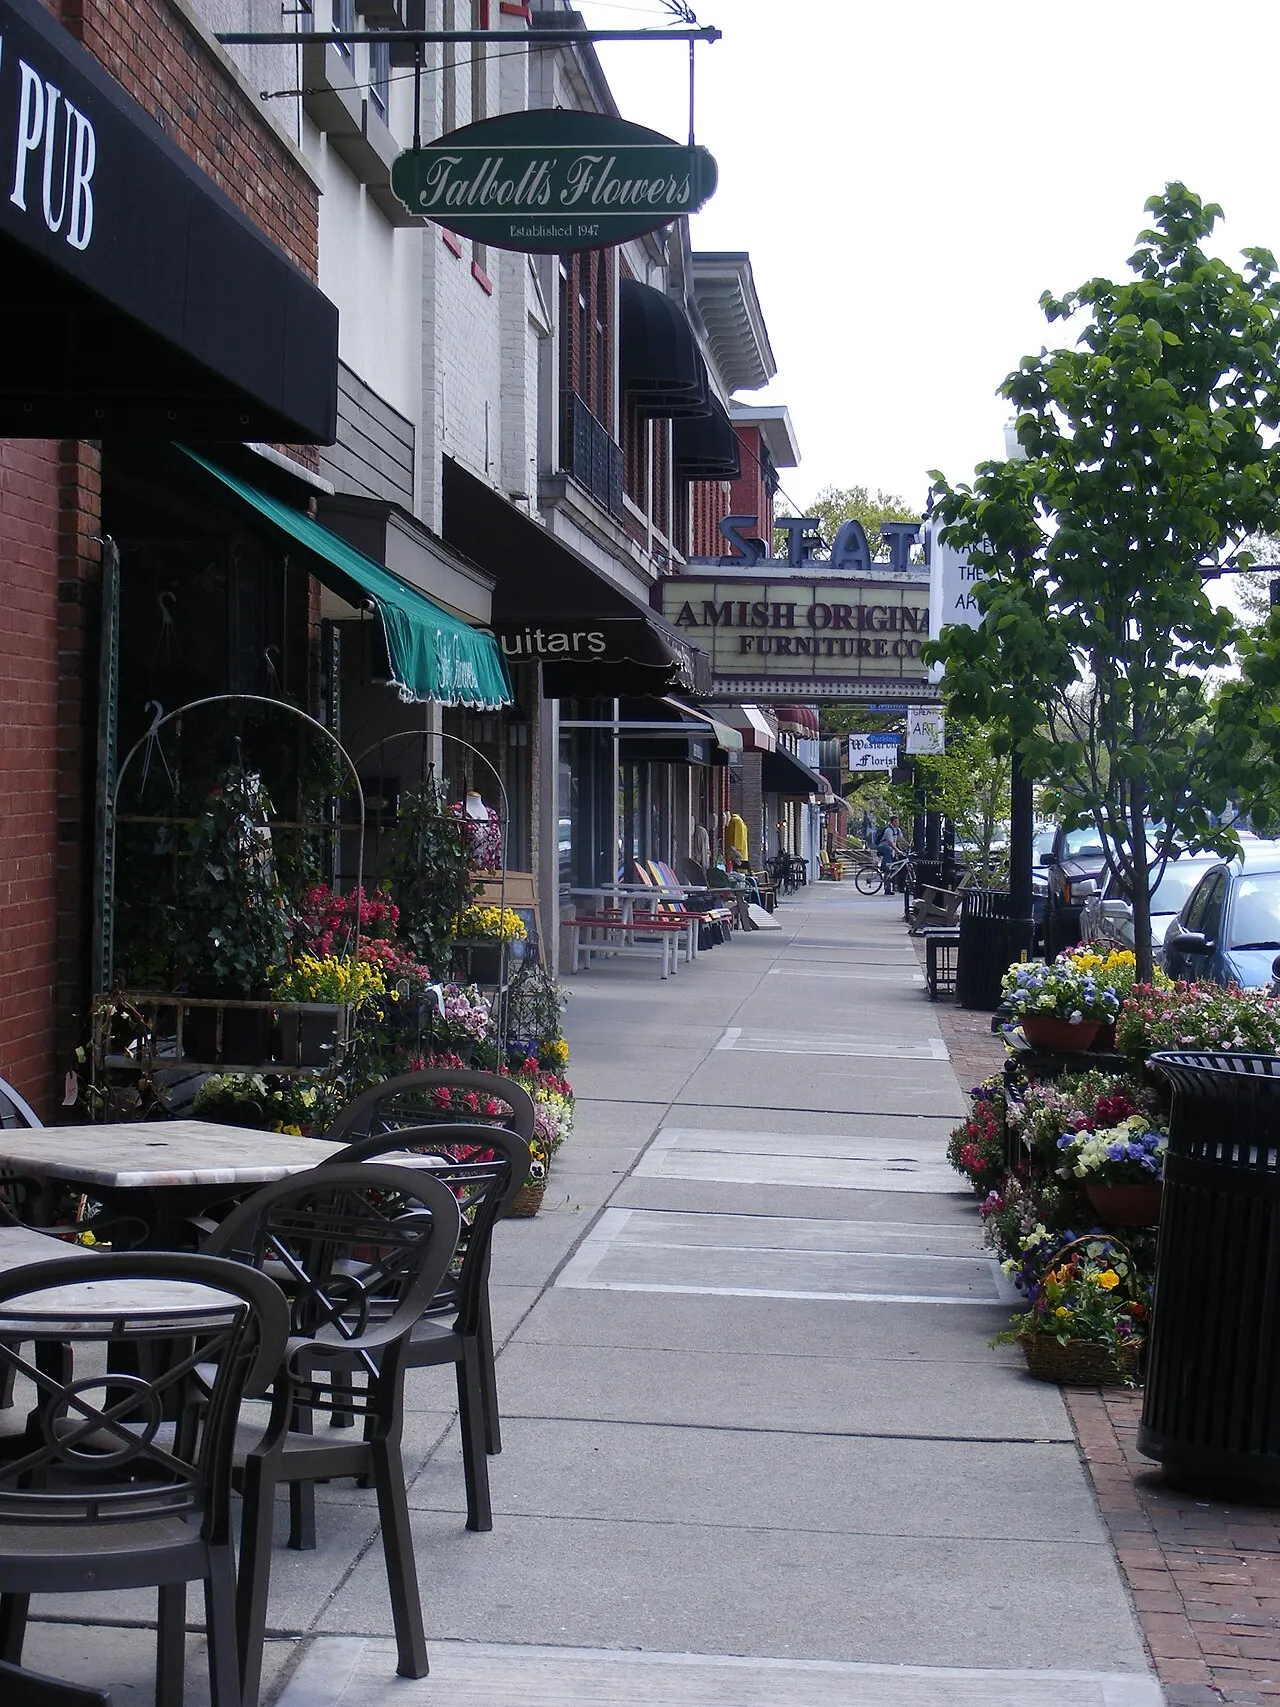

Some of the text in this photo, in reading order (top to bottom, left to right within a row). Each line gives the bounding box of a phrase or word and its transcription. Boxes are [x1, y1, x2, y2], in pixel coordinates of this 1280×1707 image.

[10, 58, 96, 251] PUB
[560, 155, 691, 205] Flowers
[509, 223, 600, 237] Established 1947
[719, 515, 929, 572] STAT
[673, 600, 798, 629] AMISH
[475, 627, 607, 655] uitars
[738, 634, 889, 658] FURNITURE
[856, 754, 897, 767] Florist
